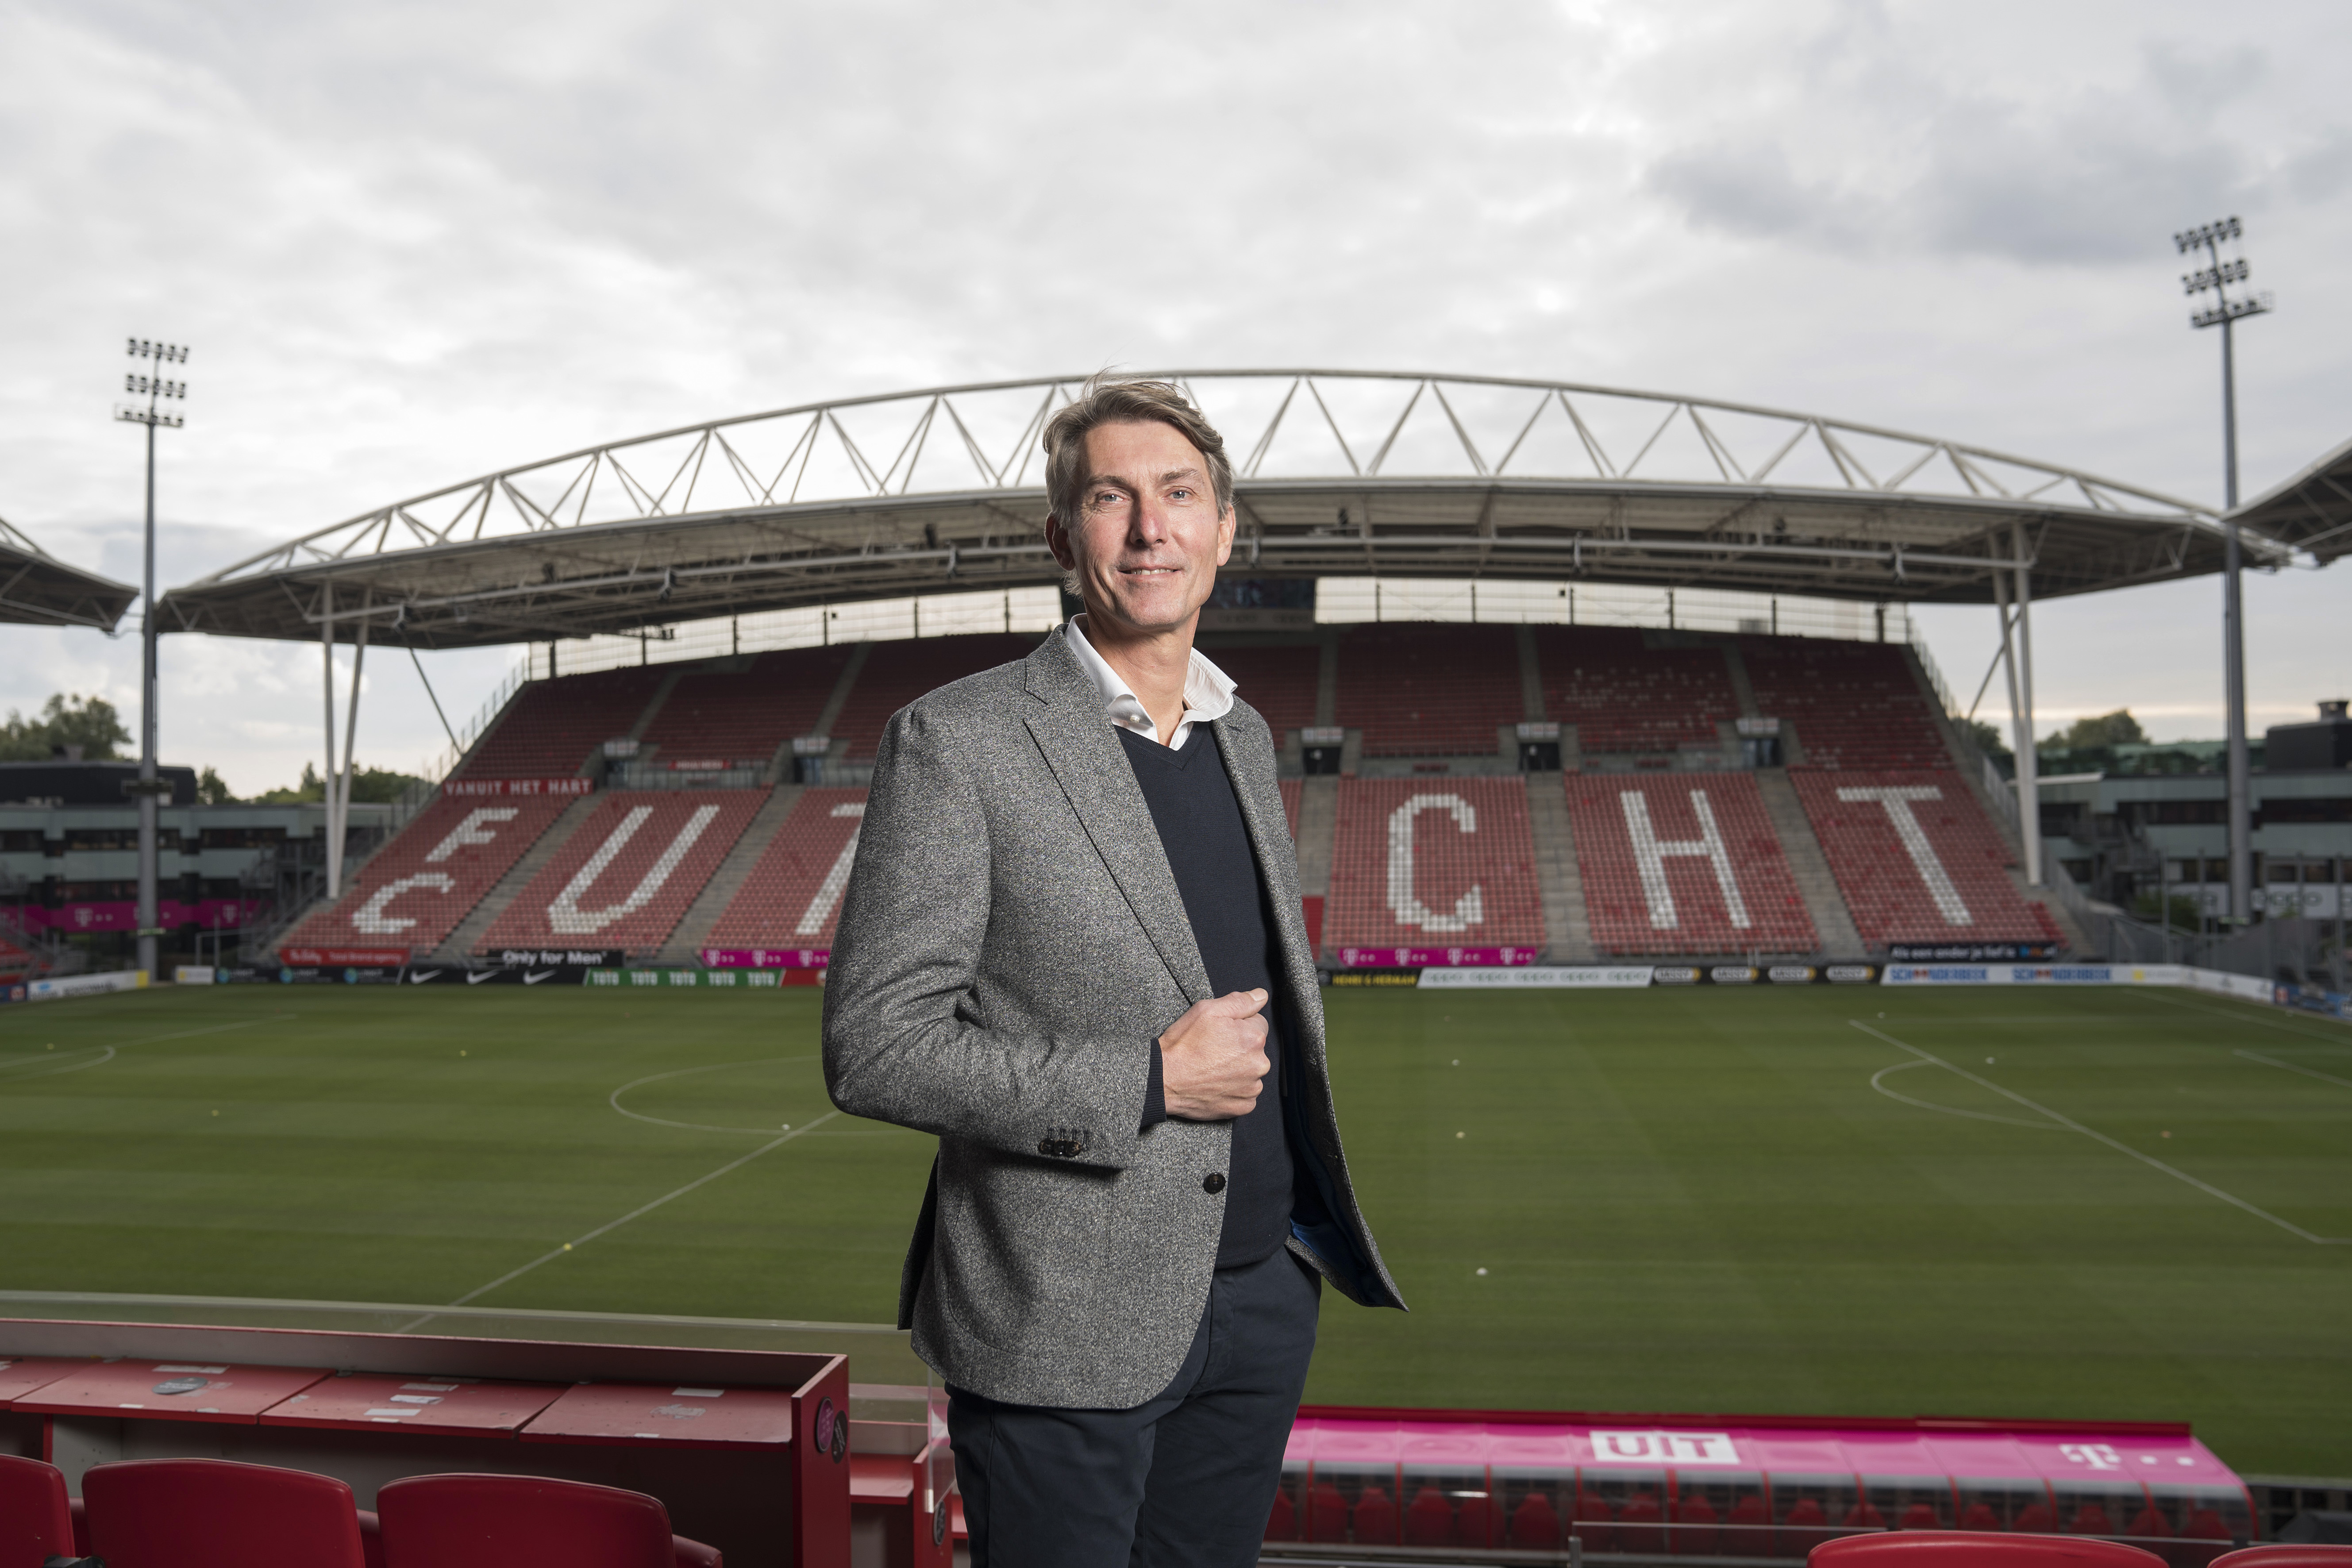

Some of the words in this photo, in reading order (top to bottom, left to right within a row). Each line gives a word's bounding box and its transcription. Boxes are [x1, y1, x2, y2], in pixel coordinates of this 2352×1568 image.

[445, 780, 503, 795] VANUIT
[510, 779, 540, 795] HET
[548, 778, 591, 794] HART
[502, 950, 537, 966] Only
[540, 951, 564, 964] for
[1332, 975, 1362, 986] HENRI
[1373, 975, 1416, 986] HERMAN
[1605, 1436, 1718, 1459] UIT
